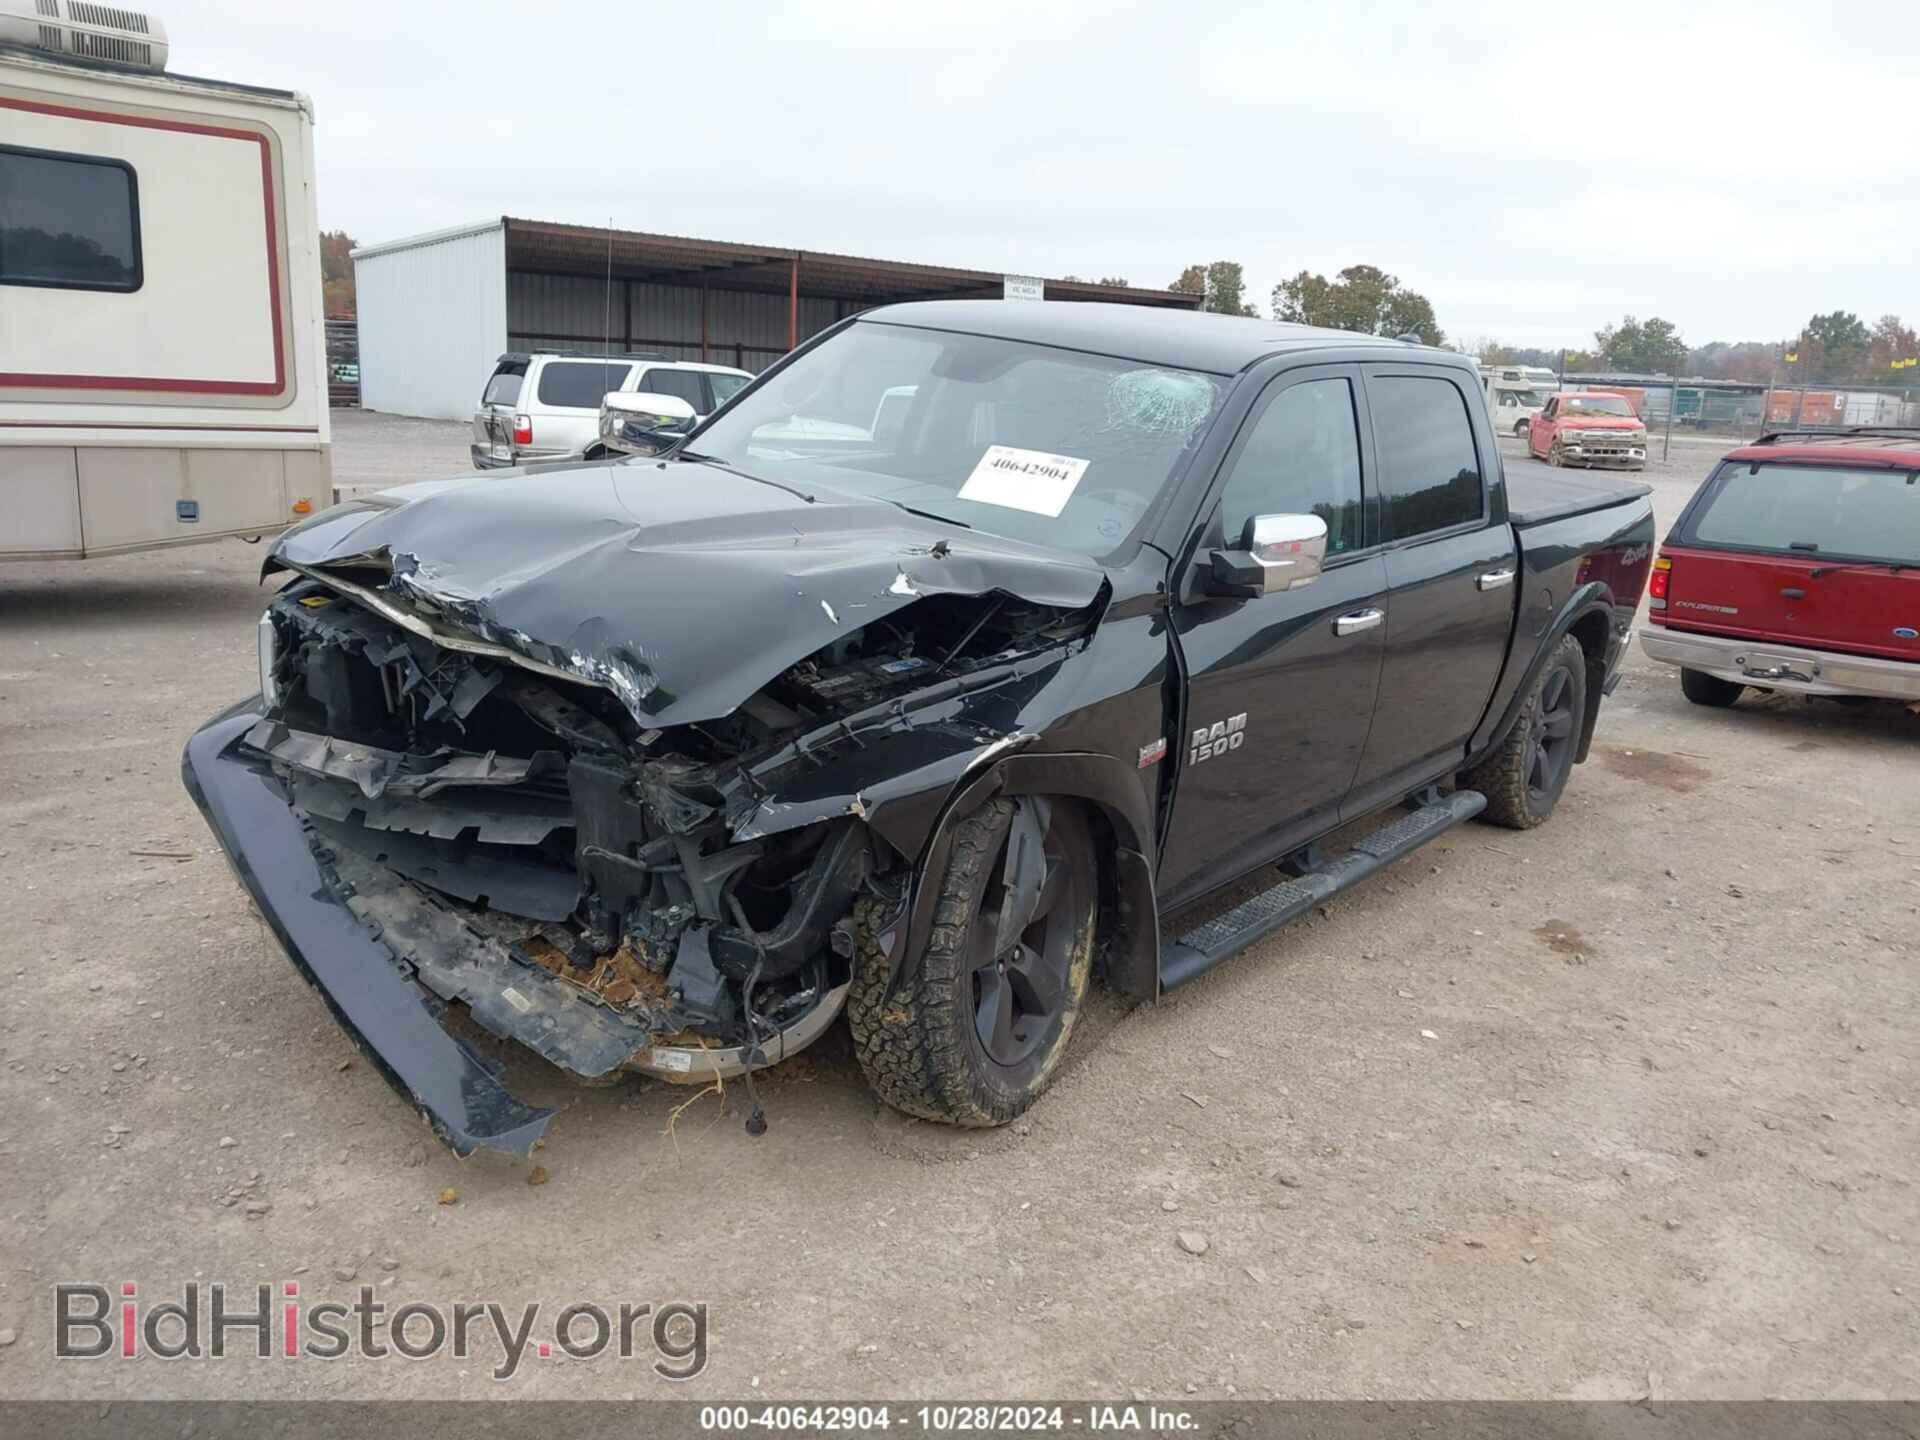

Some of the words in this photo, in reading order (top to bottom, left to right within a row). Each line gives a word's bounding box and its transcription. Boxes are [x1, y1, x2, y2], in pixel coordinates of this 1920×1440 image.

[991, 457, 1070, 481] 40642904
[1191, 711, 1248, 748] RAM
[1188, 731, 1246, 767] 1500
